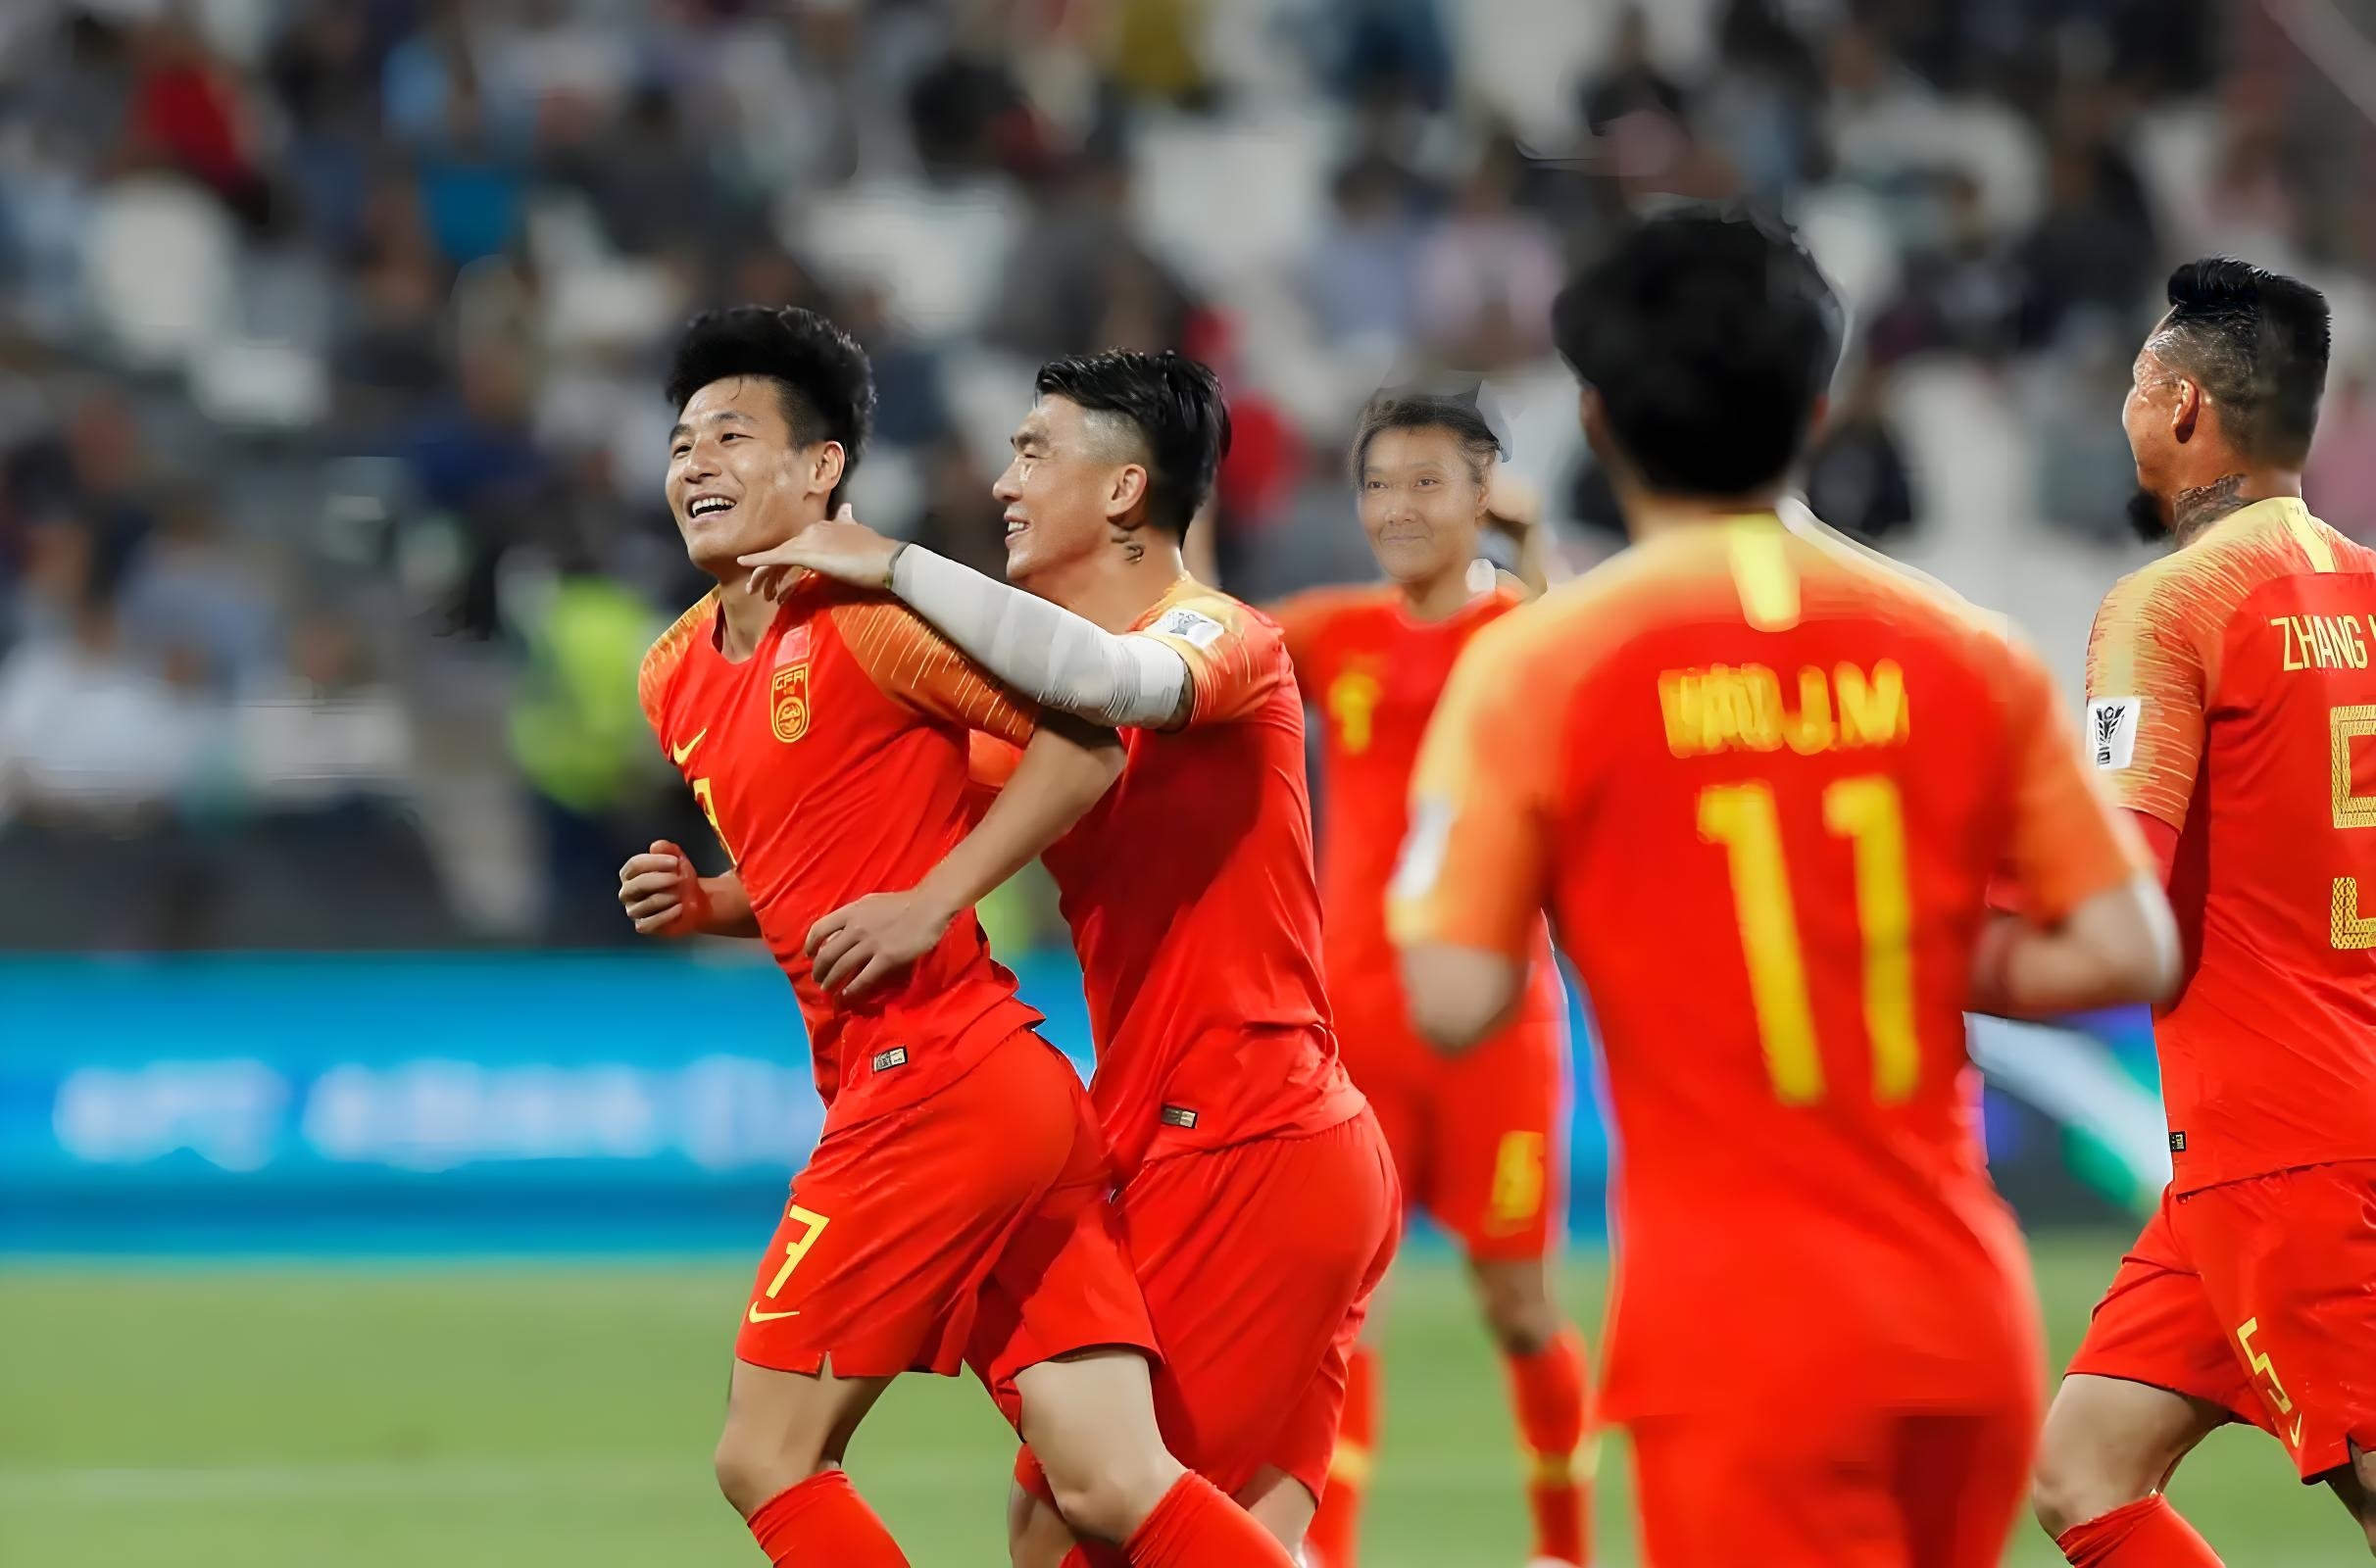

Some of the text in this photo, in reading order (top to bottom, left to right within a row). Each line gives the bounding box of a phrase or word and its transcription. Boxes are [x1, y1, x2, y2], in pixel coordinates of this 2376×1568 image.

[2270, 613, 2368, 671] ZHANG
[1697, 779, 1921, 1106] 11
[766, 1204, 830, 1299] 7
[2236, 1316, 2292, 1414] 5
